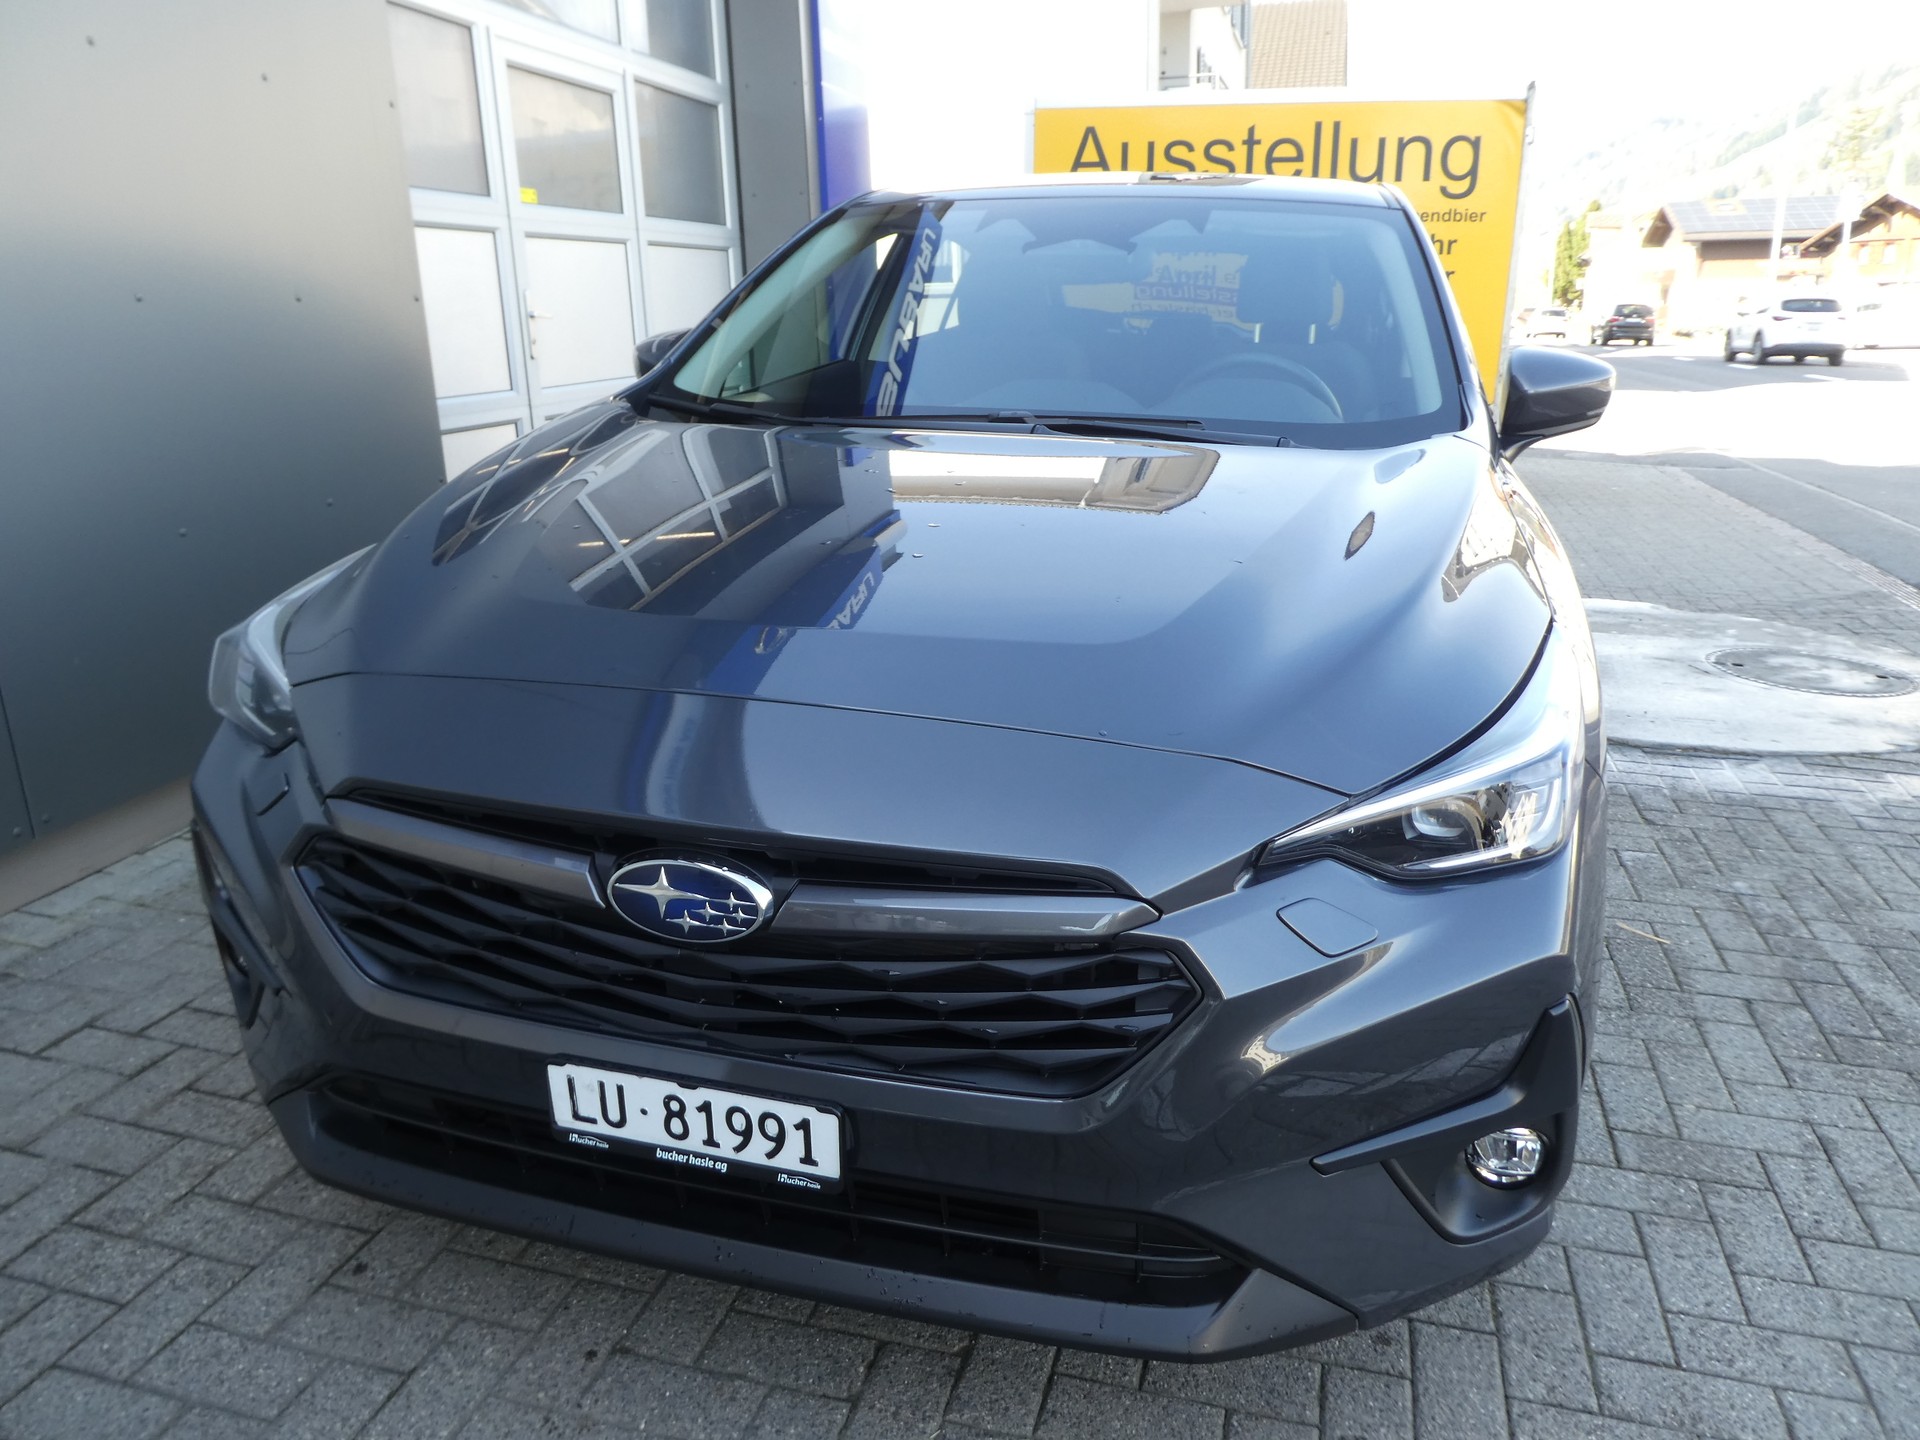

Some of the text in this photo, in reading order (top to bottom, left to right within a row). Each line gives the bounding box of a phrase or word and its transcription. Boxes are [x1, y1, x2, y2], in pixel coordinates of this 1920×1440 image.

[1070, 120, 1482, 200] Ausstellung
[1418, 208, 1487, 223] endbier
[662, 1094, 819, 1167] 81991
[656, 1147, 728, 1173] bucher hasle ag
